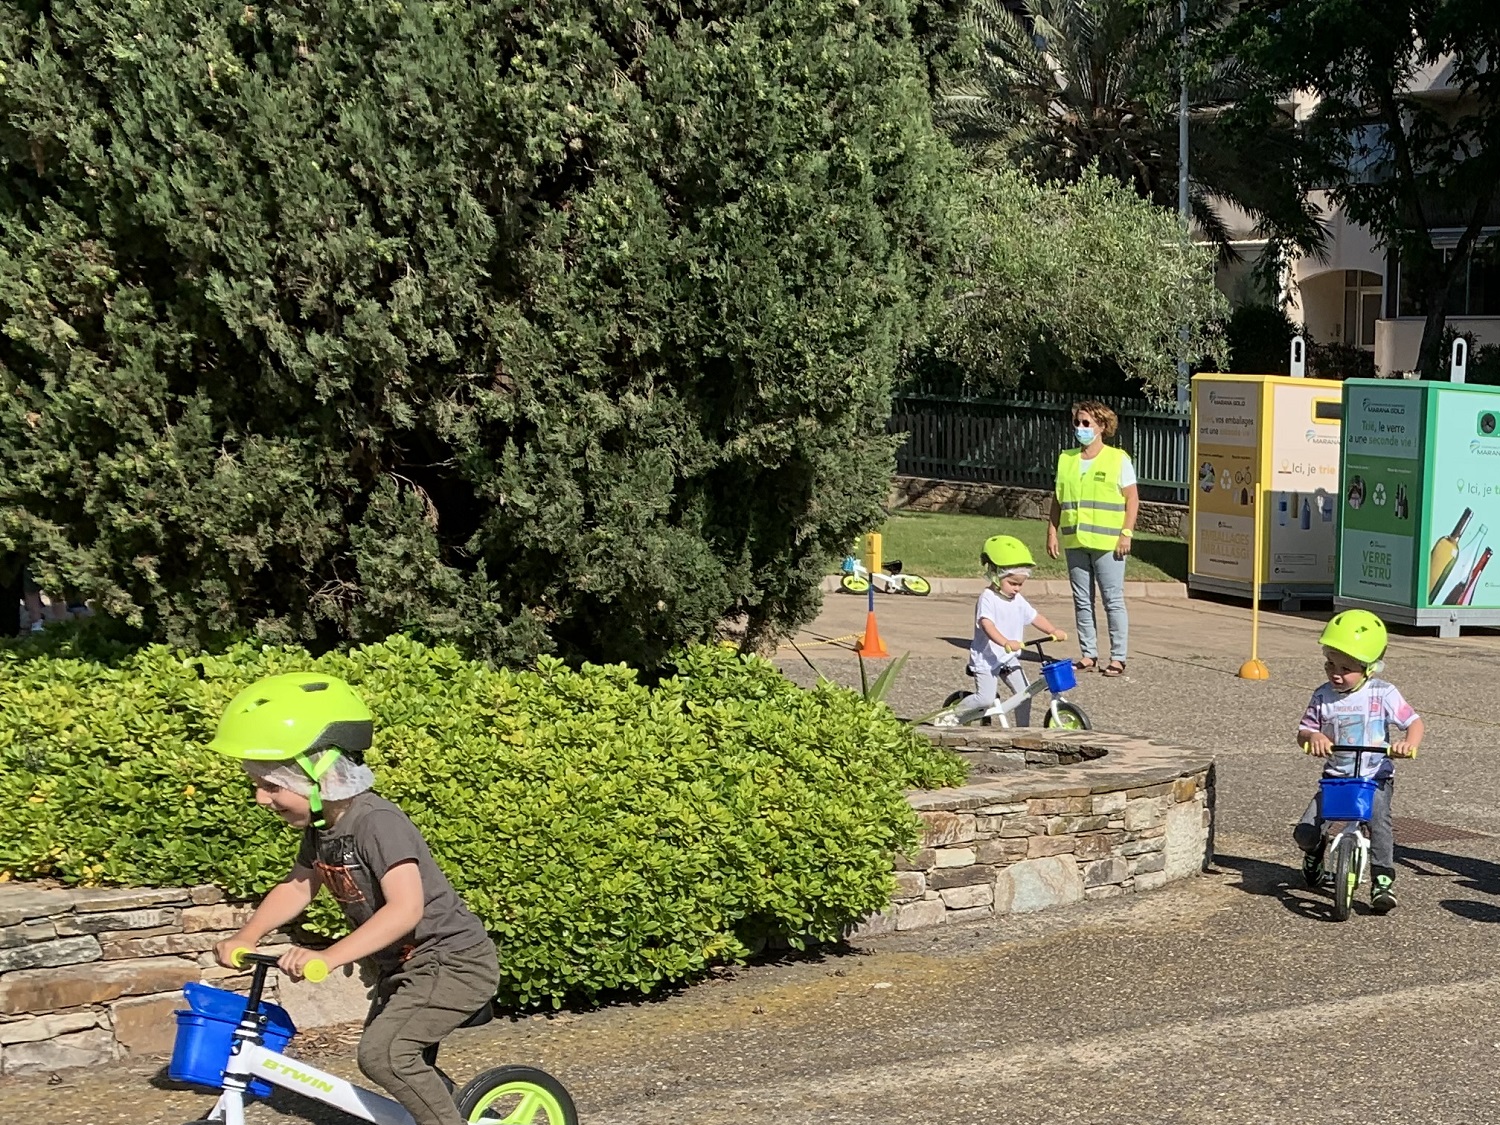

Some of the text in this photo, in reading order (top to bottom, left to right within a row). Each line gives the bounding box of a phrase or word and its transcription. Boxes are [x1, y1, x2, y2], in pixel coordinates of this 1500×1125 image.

[1225, 416, 1254, 427] emballages
[1378, 420, 1385, 432] le
[1386, 424, 1406, 433] verre
[1349, 435, 1354, 443] a
[1368, 436, 1399, 446] seconde
[1400, 436, 1412, 447] vie
[1292, 461, 1305, 475] Ici,
[1306, 463, 1317, 477] je
[1319, 464, 1336, 475] trie
[1467, 482, 1481, 495] Ici,
[1482, 483, 1492, 497] je
[1201, 529, 1250, 546] EMBALLAGES
[1362, 550, 1392, 566] VERRE
[1361, 564, 1392, 581] VETRU
